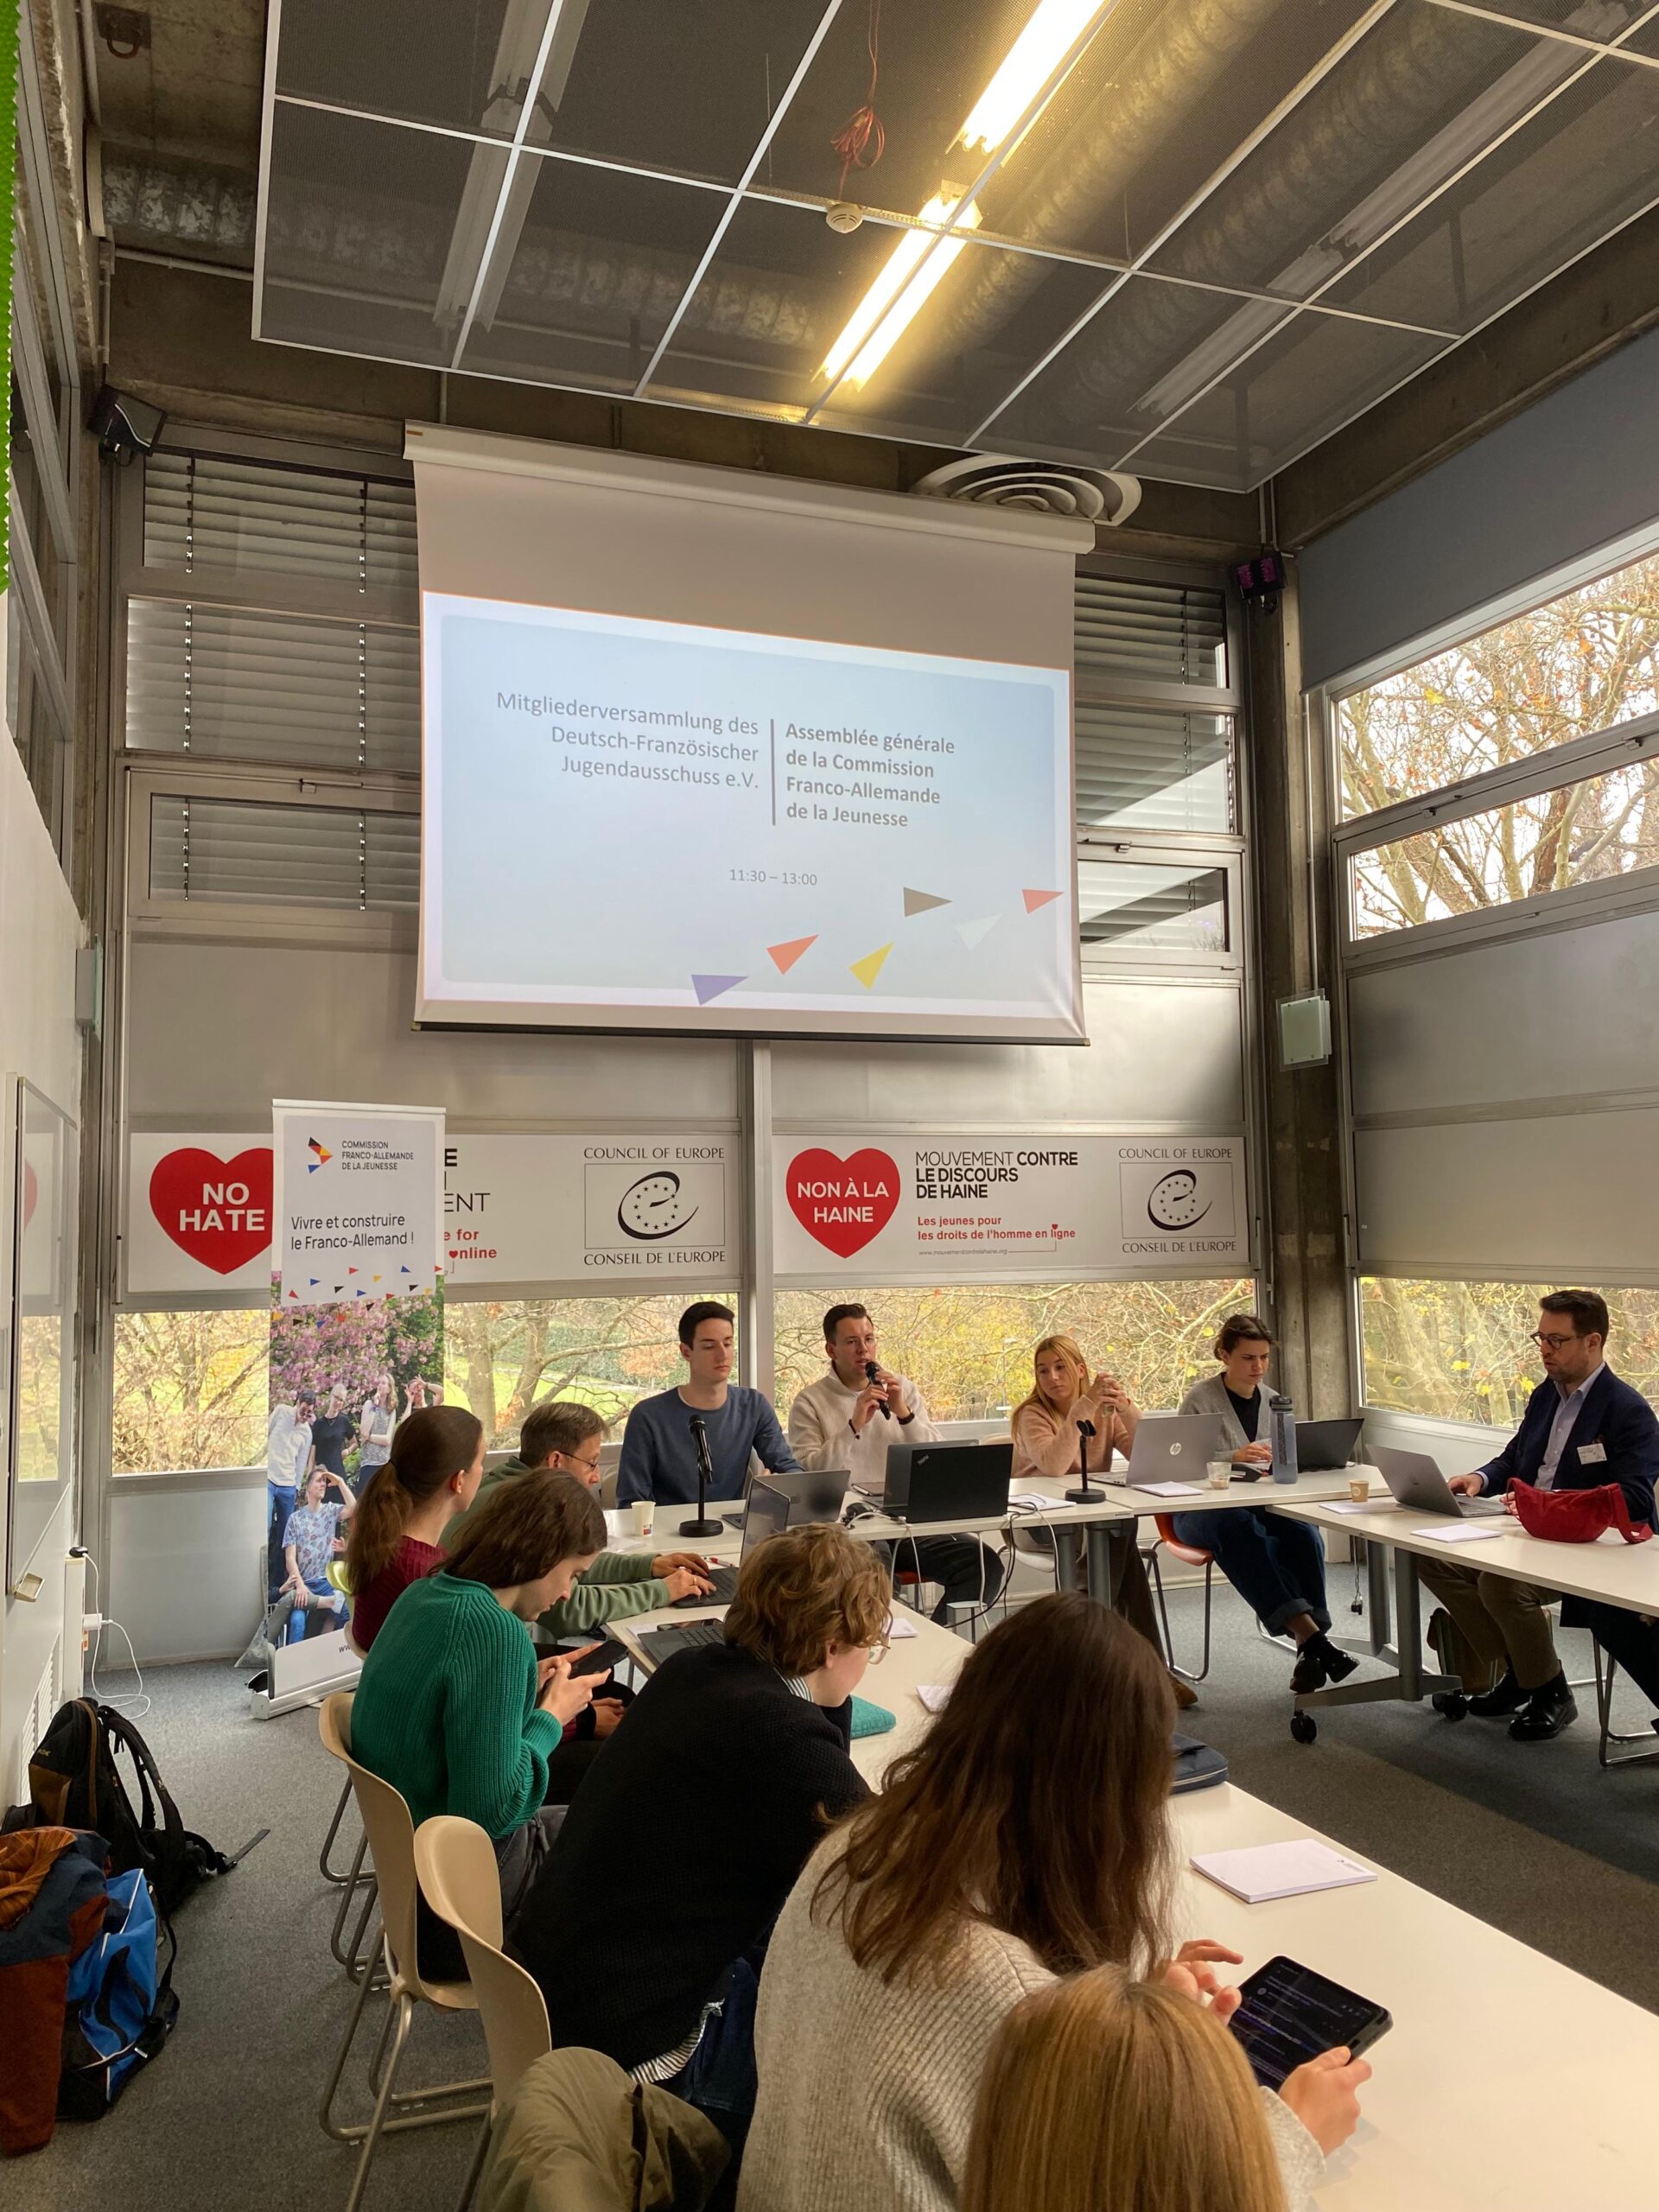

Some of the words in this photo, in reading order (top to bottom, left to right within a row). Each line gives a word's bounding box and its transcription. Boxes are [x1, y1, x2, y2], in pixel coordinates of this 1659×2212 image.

[496, 691, 723, 734] Mitgliederversammlung
[728, 716, 759, 734] des
[551, 726, 759, 761] Deutsch-Französischer
[785, 723, 879, 746] Assemblée
[882, 733, 955, 753] générale
[562, 755, 720, 785] Jugendausschuss
[725, 772, 759, 789] e.V.
[785, 749, 808, 766] de
[813, 751, 828, 768] la
[832, 754, 934, 778] Commission
[786, 776, 941, 804] Franco-Allemande
[786, 803, 808, 819] de
[813, 804, 828, 820] la
[832, 806, 908, 827] Jeunesse
[729, 869, 766, 883] 11:30
[781, 872, 817, 886] 13:00
[341, 1140, 388, 1149] COMMISSION
[341, 1151, 414, 1160] FRANCO-ALLEMANDE
[583, 1147, 648, 1160] COUNCIL
[652, 1147, 671, 1159] OF
[676, 1147, 725, 1159] EUROPE
[915, 1151, 1014, 1166] MOUVEMENT
[1016, 1151, 1078, 1166] CONTRE
[1118, 1148, 1170, 1159] COUNCIL
[1173, 1148, 1188, 1158] OF
[1192, 1148, 1232, 1159] EUROPE
[915, 1168, 935, 1183] LE
[938, 1167, 1019, 1183] DISCOURS
[202, 1182, 250, 1205] NO
[797, 1182, 841, 1198] NON
[844, 1178, 859, 1198] À
[863, 1182, 889, 1198] LA
[916, 1184, 938, 1198] DE
[940, 1184, 988, 1198] HAINE
[444, 1193, 491, 1212] ENT
[179, 1209, 265, 1231] HATE
[290, 1216, 323, 1230] Vivre
[326, 1216, 339, 1229] et
[342, 1213, 405, 1229] construire
[813, 1206, 874, 1224] HAINE
[918, 1217, 937, 1226] Les
[938, 1216, 975, 1227] jeunes
[977, 1217, 1001, 1227] pour
[290, 1236, 302, 1250] le
[305, 1231, 408, 1249] Franco-Allemand
[456, 1229, 479, 1241] for
[918, 1230, 934, 1240] les
[937, 1230, 968, 1240] droits
[970, 1230, 984, 1239] de
[987, 1230, 1033, 1239] l'homme
[1050, 1229, 1076, 1240] ligne
[1122, 1243, 1168, 1253] CONSEIL
[1172, 1242, 1185, 1252] DE
[1190, 1241, 1236, 1252] L'EUROPE
[583, 1253, 643, 1266] CONSEIL
[646, 1252, 664, 1263] DE
[668, 1250, 726, 1263] L'EUROPE
